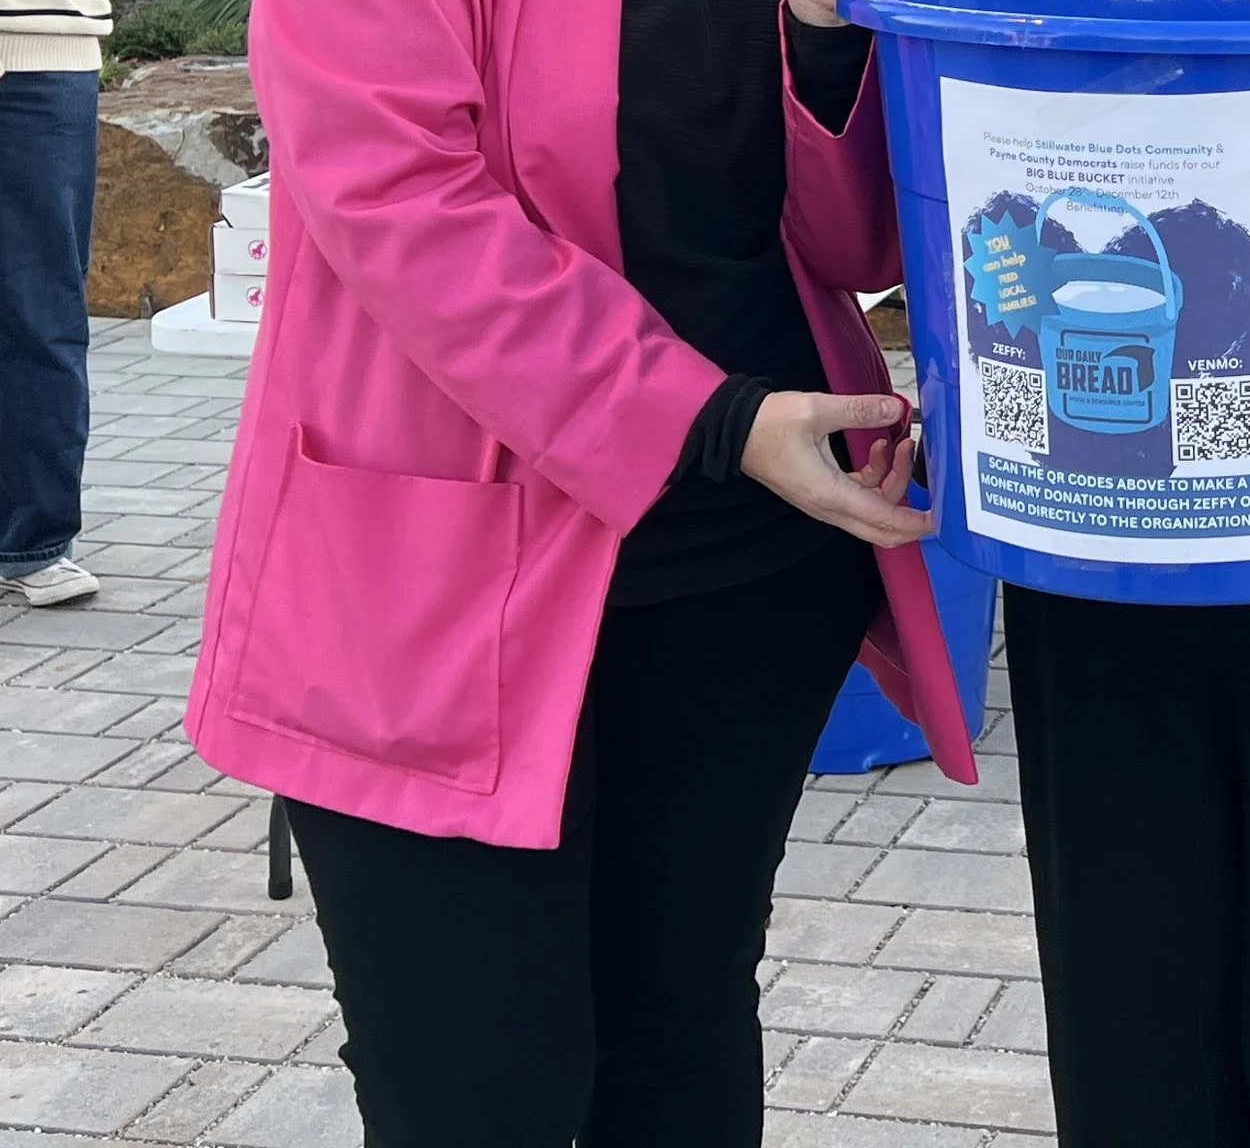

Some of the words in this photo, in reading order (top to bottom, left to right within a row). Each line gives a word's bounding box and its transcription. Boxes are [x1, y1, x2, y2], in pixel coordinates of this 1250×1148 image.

[983, 132, 1011, 145] Please
[1013, 139, 1033, 150] help
[1035, 140, 1086, 152] Stillwater
[1088, 143, 1113, 153] Blue
[1116, 144, 1142, 154] Dots
[1145, 144, 1212, 156] Community
[1216, 143, 1224, 154] &
[989, 148, 1017, 161] Payne
[1019, 152, 1055, 167] County
[1058, 156, 1118, 169] Democrats
[1120, 160, 1145, 170] raise
[1149, 159, 1180, 170] funds
[1183, 159, 1197, 169] for
[1201, 161, 1220, 169] our
[1026, 167, 1045, 179] BIG
[1047, 171, 1076, 181] BLUE
[1078, 172, 1125, 184] BUCKET
[1127, 174, 1175, 185] initiative
[1025, 182, 1066, 196] October
[1096, 188, 1152, 200] December
[1157, 189, 1180, 200] 12th
[1066, 201, 1128, 216] Benefitting:
[984, 234, 1011, 254] YOU
[1001, 252, 1026, 268] help
[999, 284, 1027, 299] LOCAL
[992, 342, 1026, 360] ZEFFY:
[1055, 348, 1074, 361] OUR
[1075, 350, 1102, 363] DAILY
[1187, 357, 1243, 371] VENMO:
[1056, 361, 1132, 395] BREAD
[988, 456, 1019, 475] SCAN
[1020, 465, 1045, 481] THE
[1046, 470, 1065, 485] QR
[1068, 473, 1114, 490] CODES
[1116, 478, 1166, 491] ABOVE
[1169, 479, 1189, 491] TO
[1192, 477, 1234, 491] MAKE
[1237, 477, 1248, 489] A
[981, 472, 1041, 498] MONETARY
[1044, 488, 1114, 508] DONATION
[1117, 496, 1190, 510] THROUGH
[1193, 496, 1237, 510] ZEFFY
[985, 491, 1025, 513] VENMO
[1027, 503, 1087, 524] DIRECTLY
[1089, 513, 1108, 526] TO
[1110, 515, 1138, 528] THE
